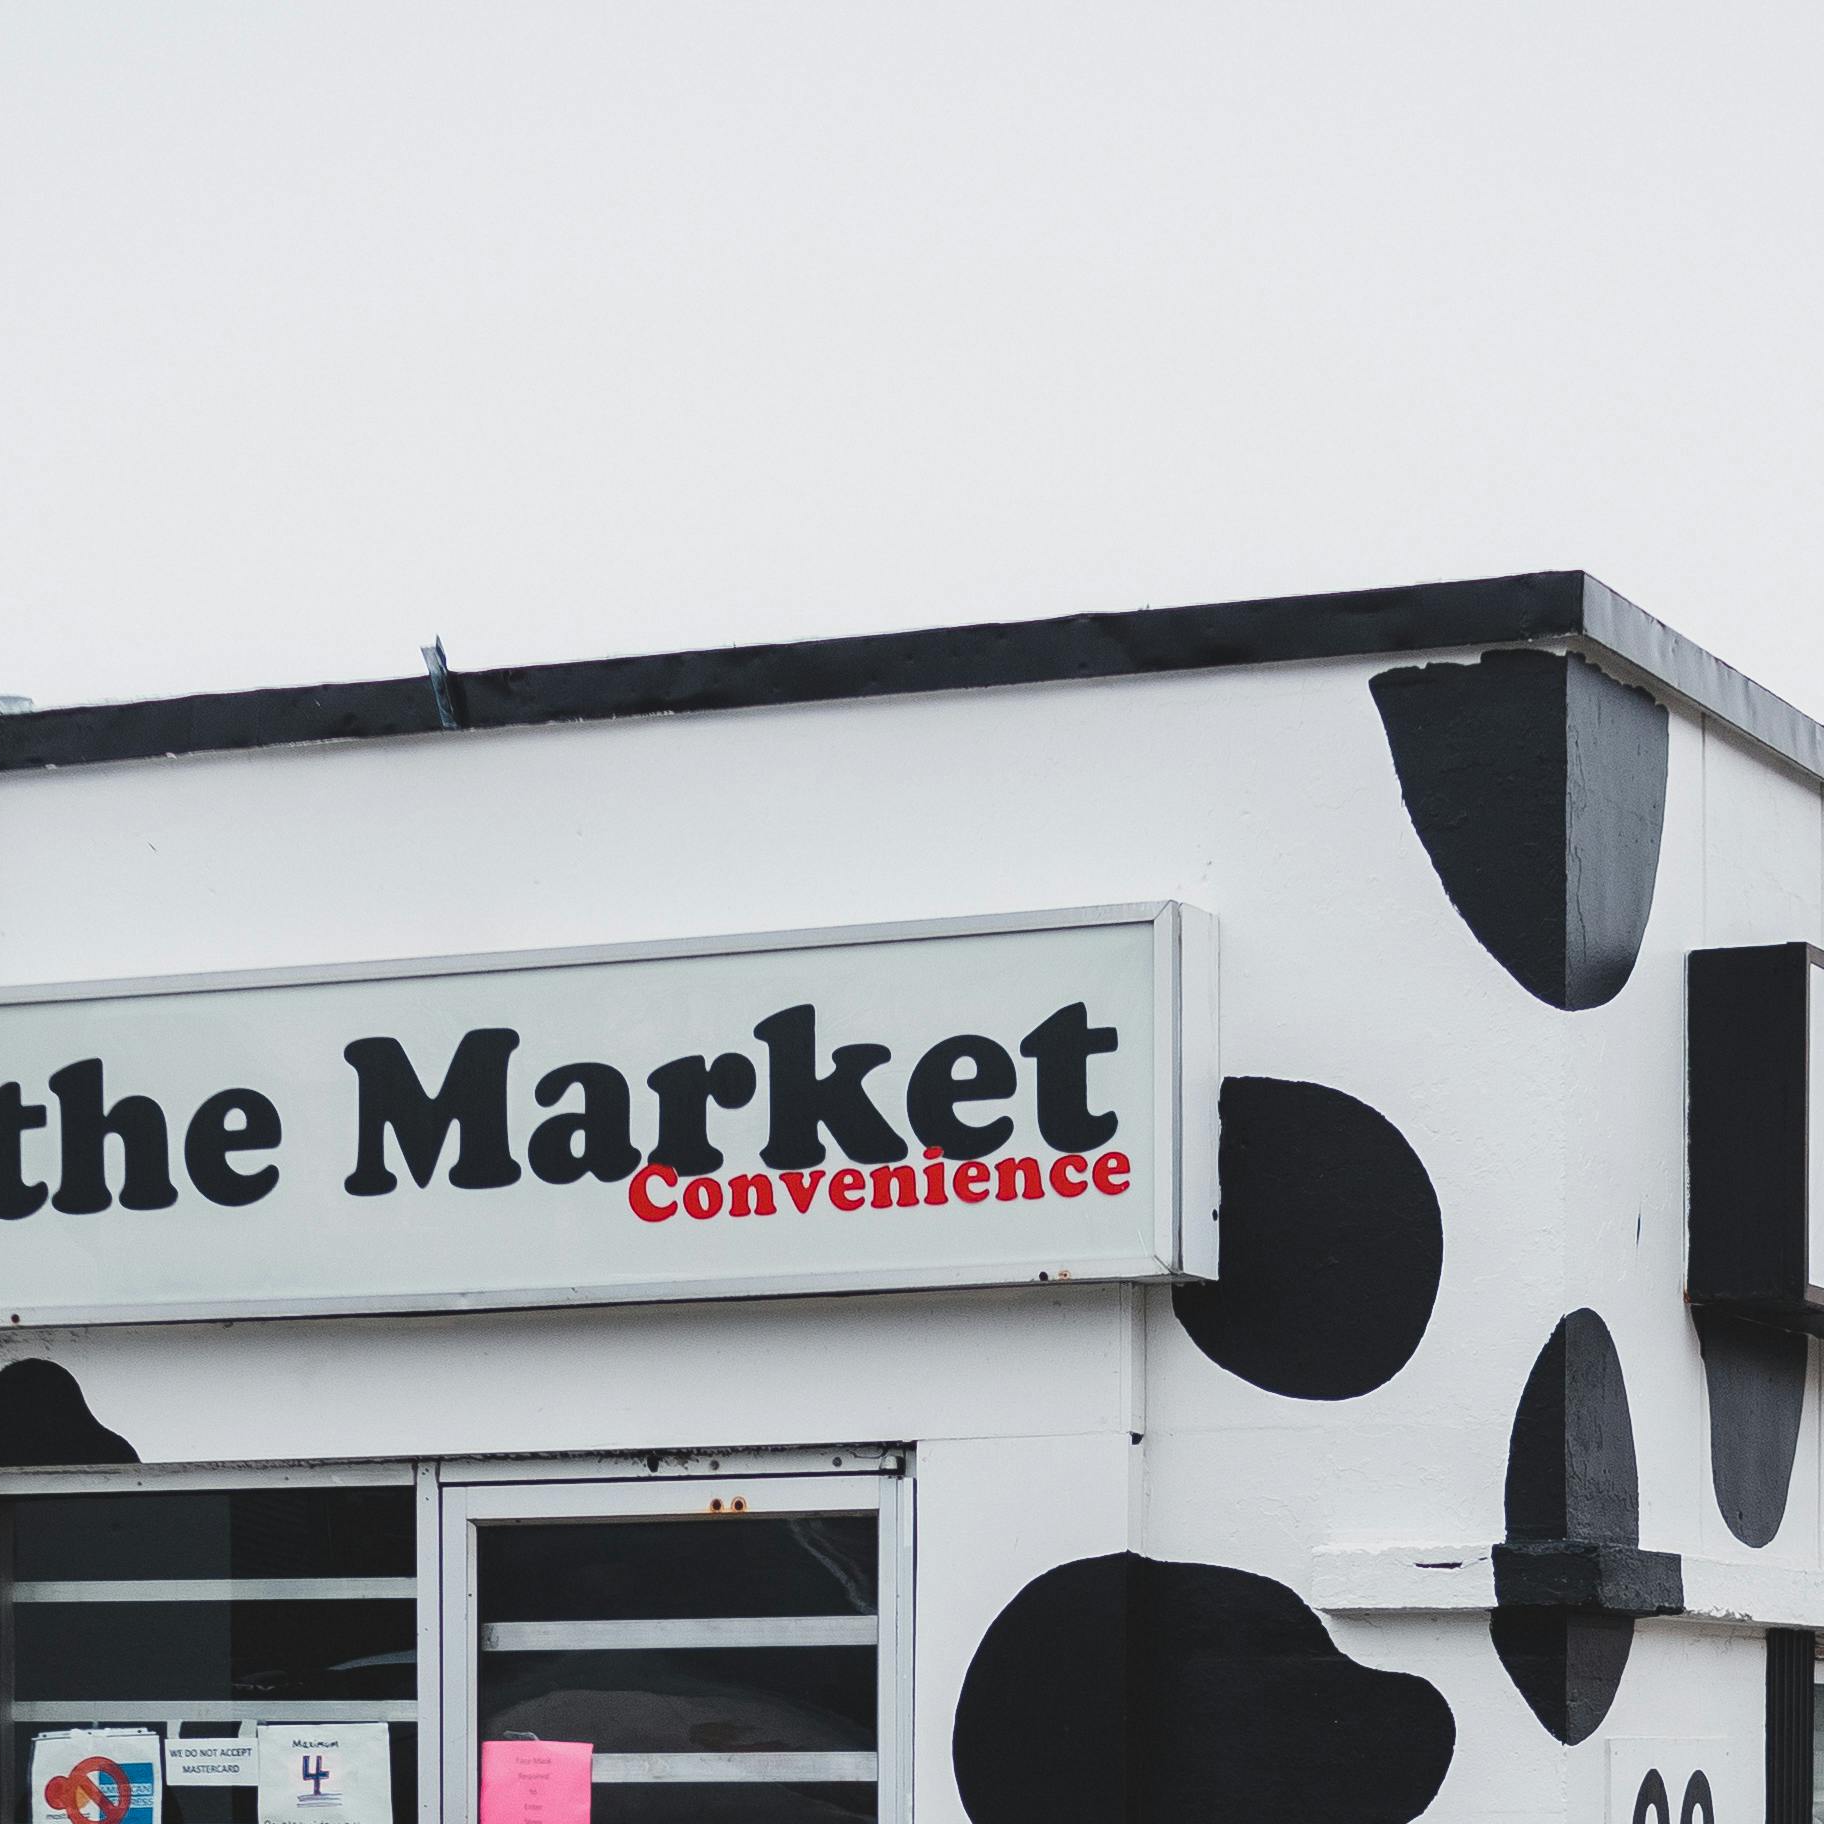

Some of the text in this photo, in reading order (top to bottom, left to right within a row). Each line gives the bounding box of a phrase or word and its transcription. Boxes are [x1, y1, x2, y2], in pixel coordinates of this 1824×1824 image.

[344, 1000, 1119, 1198] Market
[628, 1146, 1131, 1223] Convenience
[169, 1747, 252, 1758] WE DO NOT ACCEPT
[182, 1764, 240, 1774] MASTERCARD
[303, 1755, 329, 1796] 4
